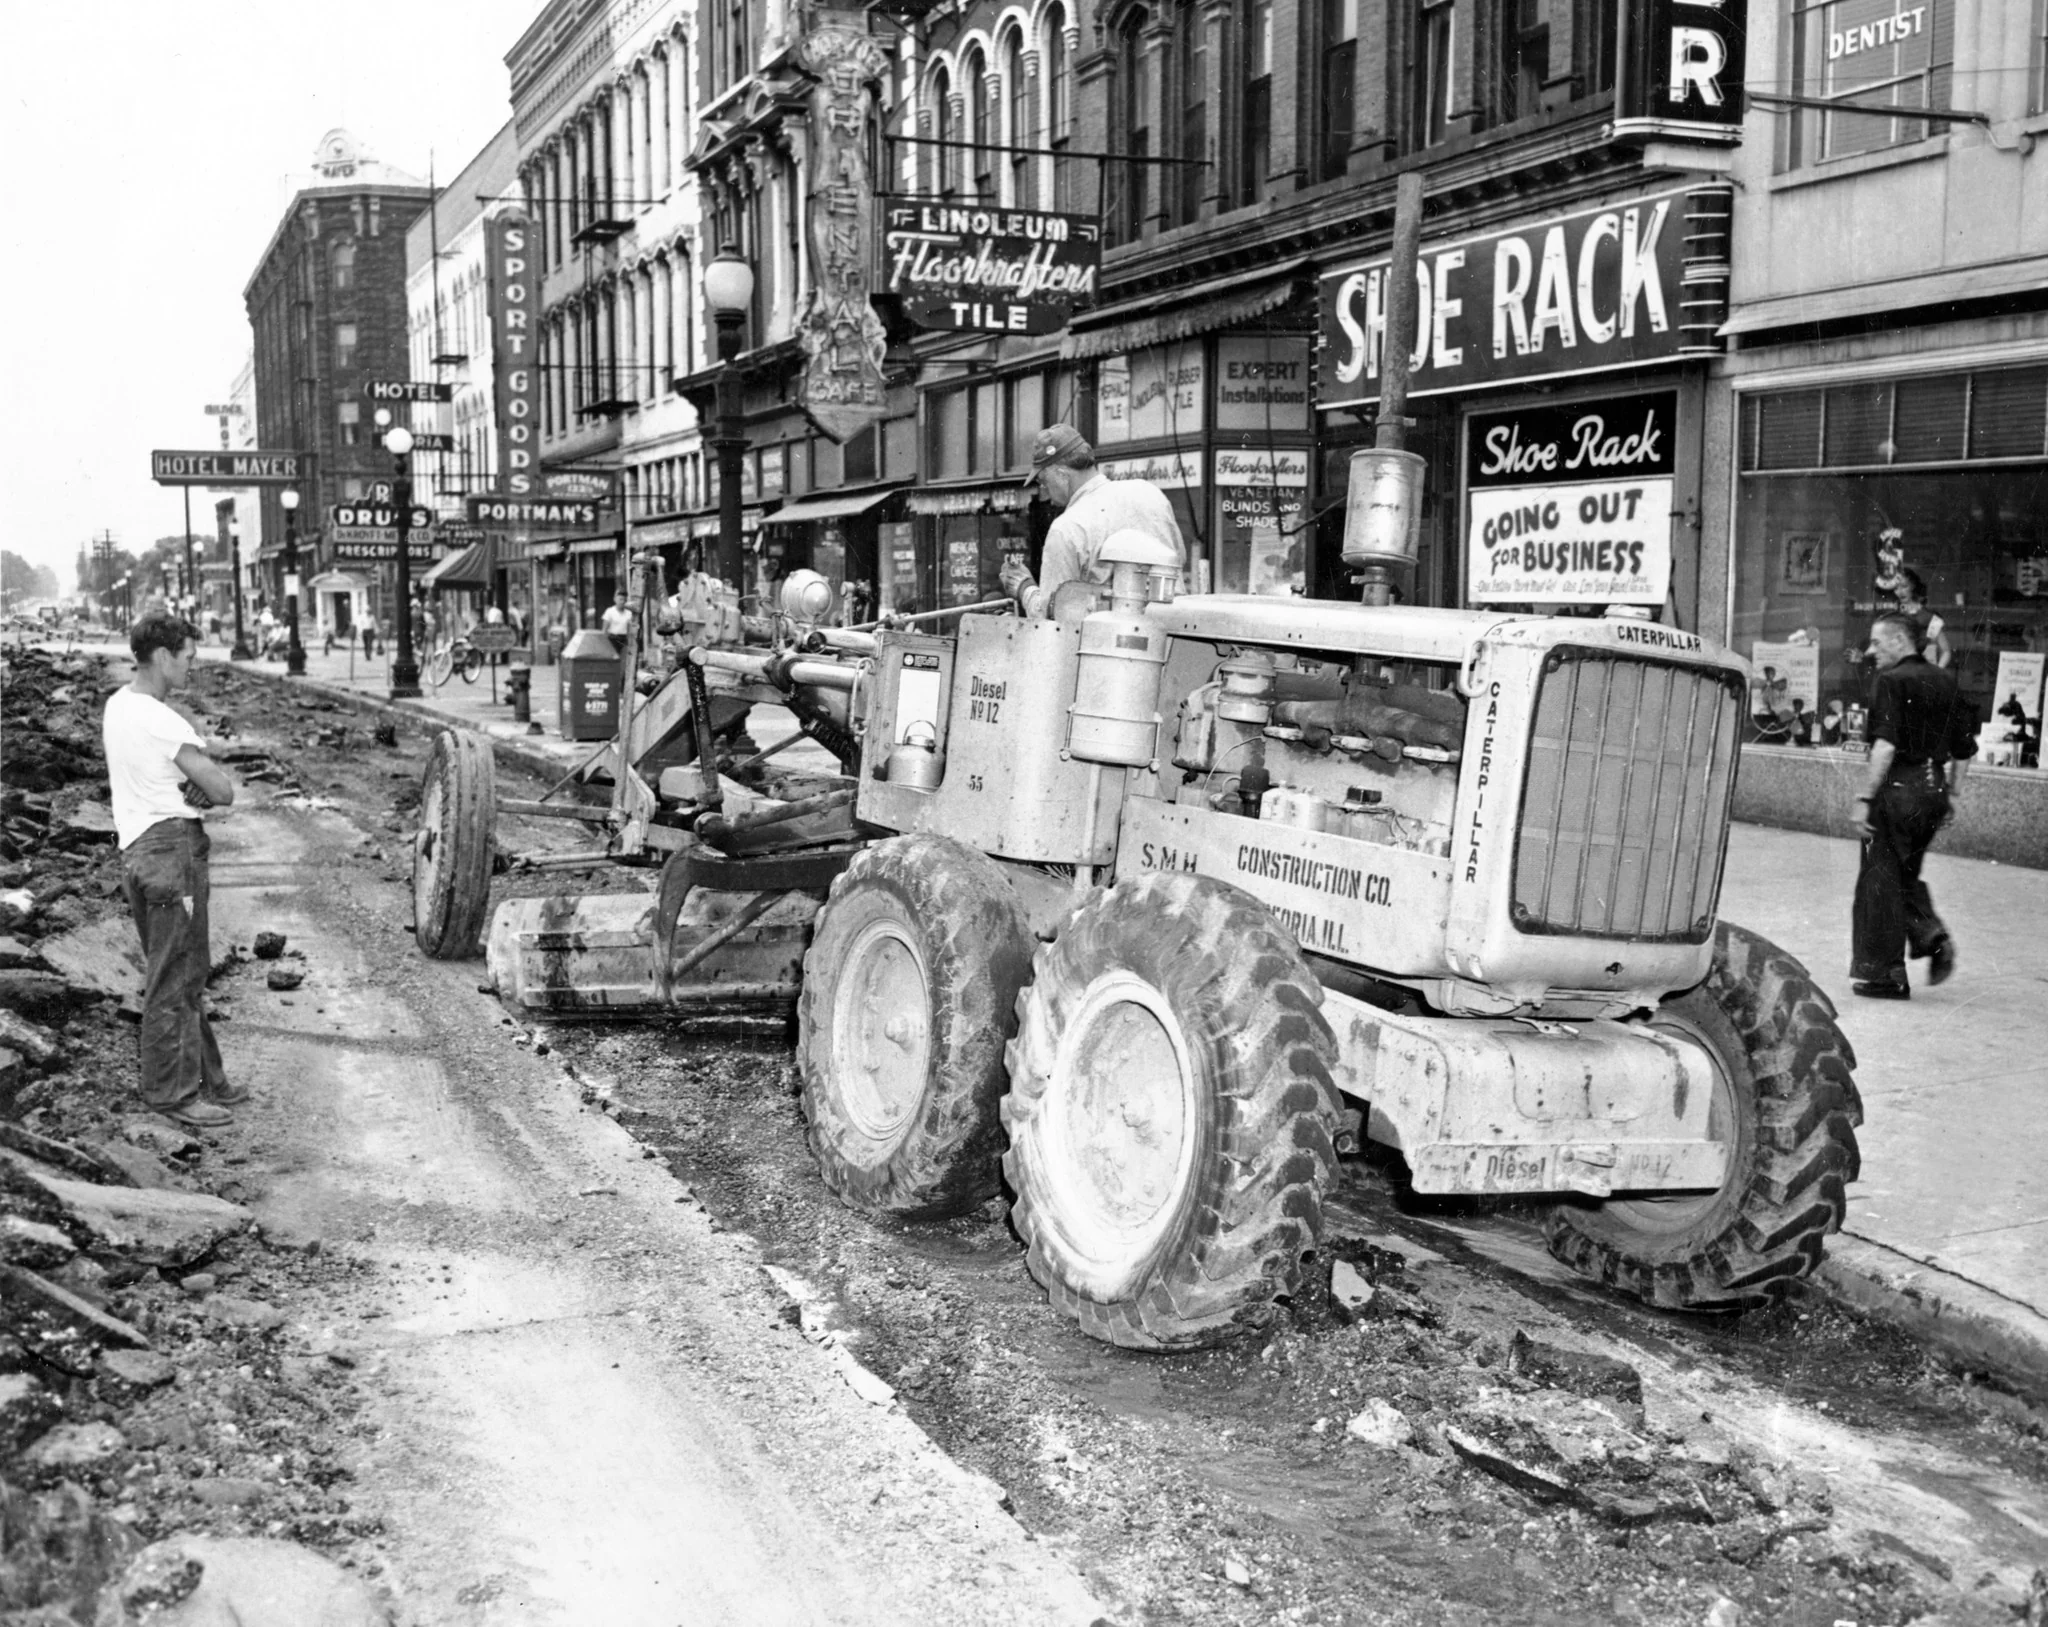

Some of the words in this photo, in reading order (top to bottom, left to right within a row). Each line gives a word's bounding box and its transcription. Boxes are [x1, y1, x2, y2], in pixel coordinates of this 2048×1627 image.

[1828, 7, 1927, 60] DENTIST
[504, 227, 527, 355] SPORT
[1493, 200, 1672, 360] RACK
[950, 302, 1029, 331] TILE
[1227, 361, 1300, 380] EXPERT
[373, 383, 442, 400] HOTEL
[508, 370, 531, 494] GOODS
[1480, 421, 1558, 476] Shoe
[1566, 408, 1662, 470] Rack
[158, 457, 226, 476] HOTEL
[232, 457, 297, 477] MAYER
[1229, 487, 1295, 498] VENETIAN
[338, 508, 428, 527] DRUS
[478, 503, 595, 522] PORTMAN'S
[1221, 500, 1272, 514] BLINDS
[1482, 500, 1561, 549] GOING
[1579, 488, 1644, 524] OUT
[1523, 539, 1646, 576] BUSINESS
[1617, 624, 1703, 652] CATERPILLAR
[970, 675, 1007, 700] Diesel
[986, 702, 1000, 724] 12
[1465, 681, 1501, 883] CATERPILLAR
[1237, 843, 1362, 901] CONSTRUCTION
[1364, 873, 1393, 908] CO.
[1486, 1153, 1547, 1180] Diesel
